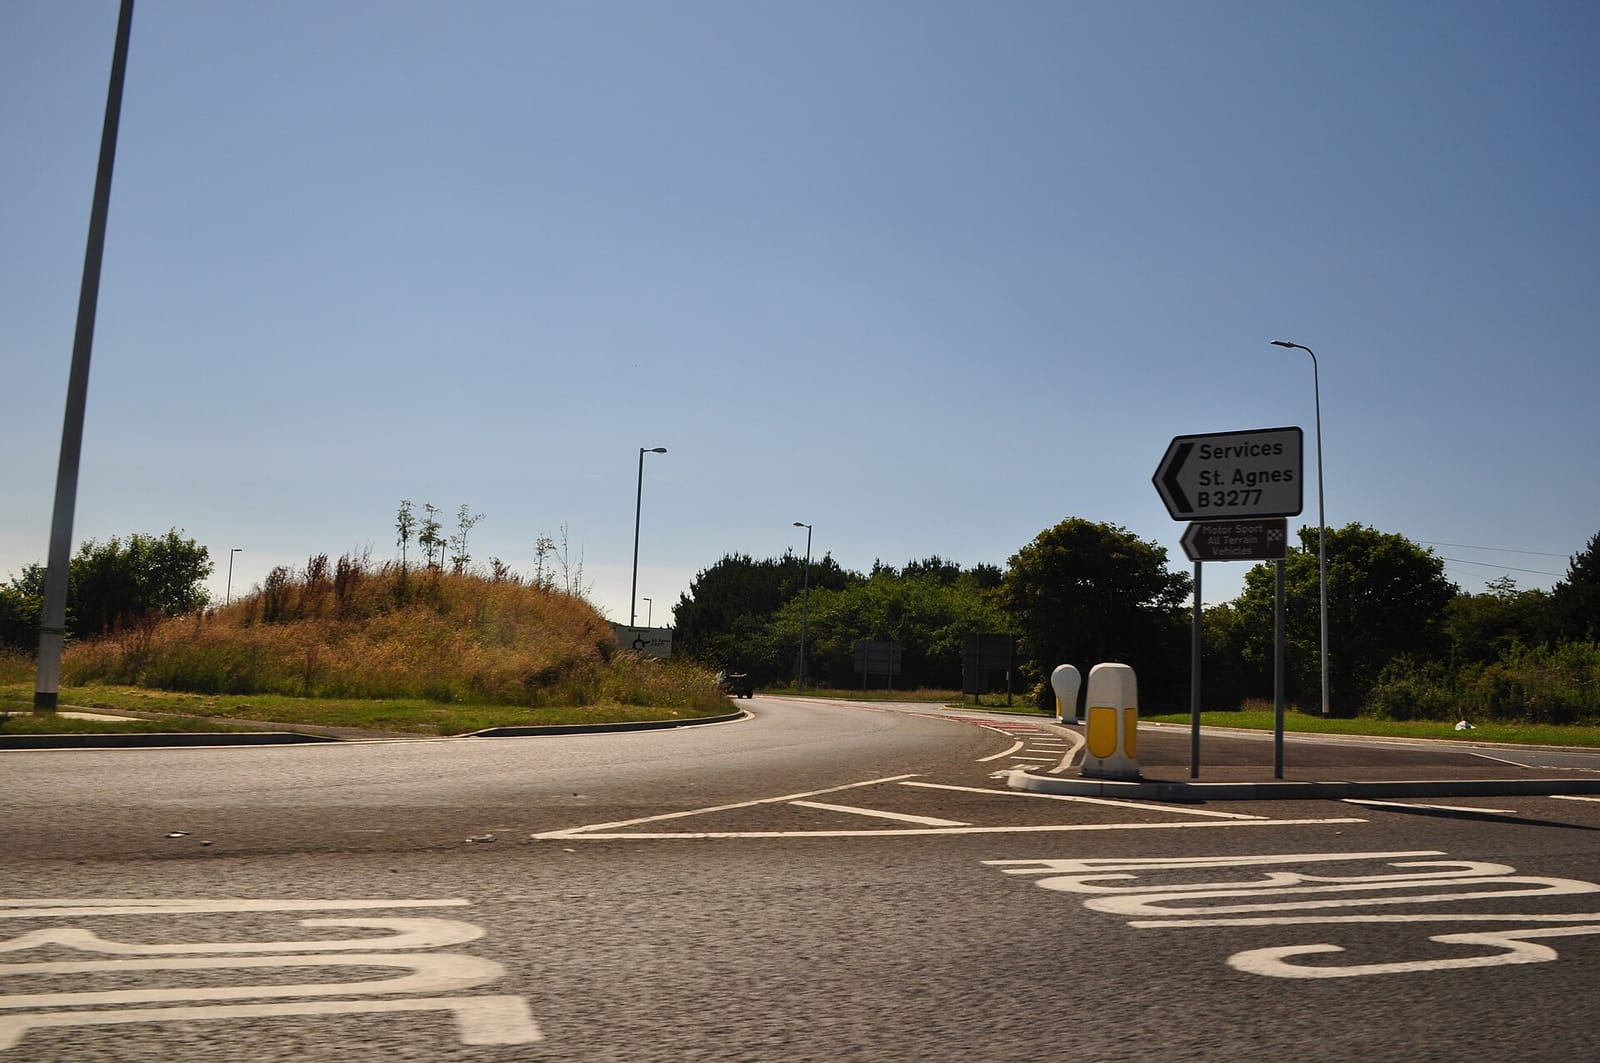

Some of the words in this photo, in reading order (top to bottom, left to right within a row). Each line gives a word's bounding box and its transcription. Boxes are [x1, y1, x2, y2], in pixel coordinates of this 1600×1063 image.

[1199, 441, 1283, 460] Services
[1198, 470, 1225, 487] St.
[1231, 468, 1293, 487] Agnes
[1198, 489, 1263, 508] B3277
[1202, 525, 1232, 536] Motor
[1235, 524, 1264, 535] Sport
[1207, 535, 1221, 545] All
[1223, 535, 1258, 545] Terrain
[1211, 546, 1253, 556] Vehicles
